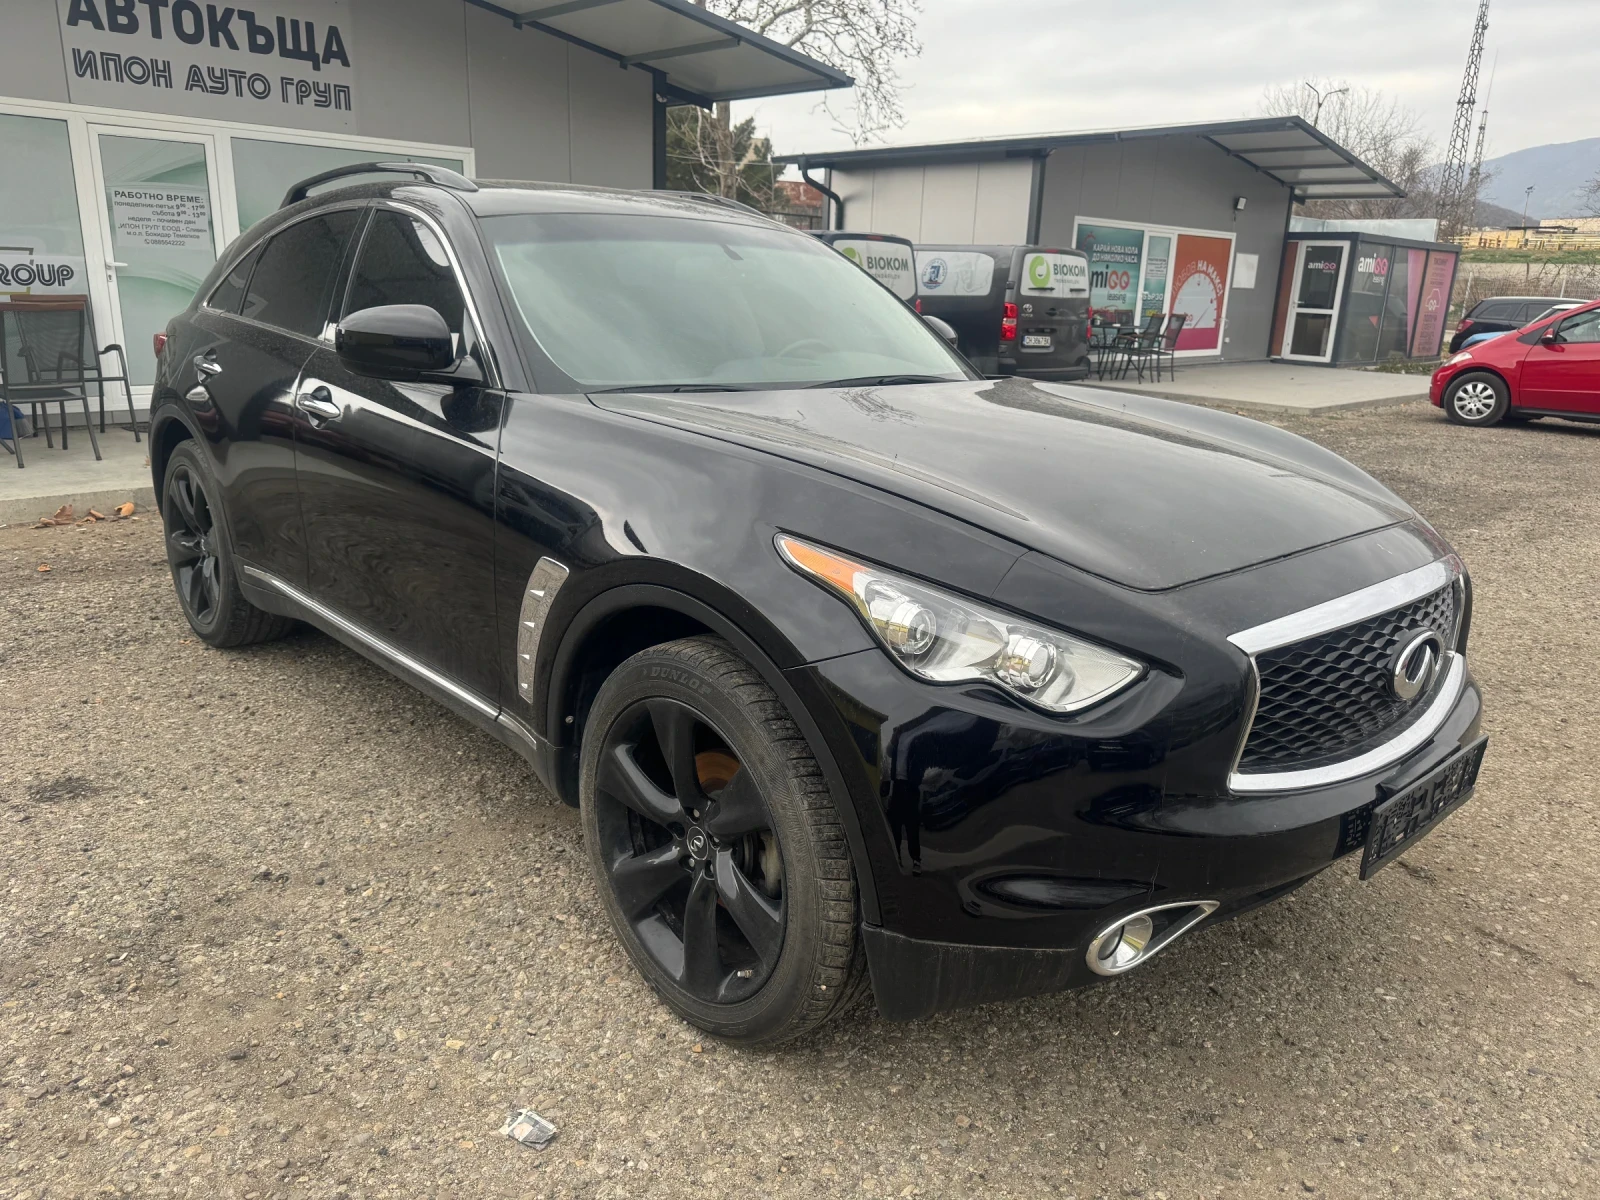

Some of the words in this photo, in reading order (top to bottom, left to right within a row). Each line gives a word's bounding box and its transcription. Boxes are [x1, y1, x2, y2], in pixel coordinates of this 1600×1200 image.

[66, 0, 351, 71] АВТОКЪЩА
[72, 48, 173, 89] ИПОН
[185, 64, 271, 100] АУТО
[281, 76, 351, 111] ГРУП
[114, 190, 163, 201] РАБОТНО
[166, 194, 203, 204] ВРЕМЕ:
[866, 256, 909, 271] BIOKOM
[1053, 263, 1086, 277] BIOKOM
[1197, 260, 1207, 272] НА
[651, 666, 712, 695] DUNLOP
